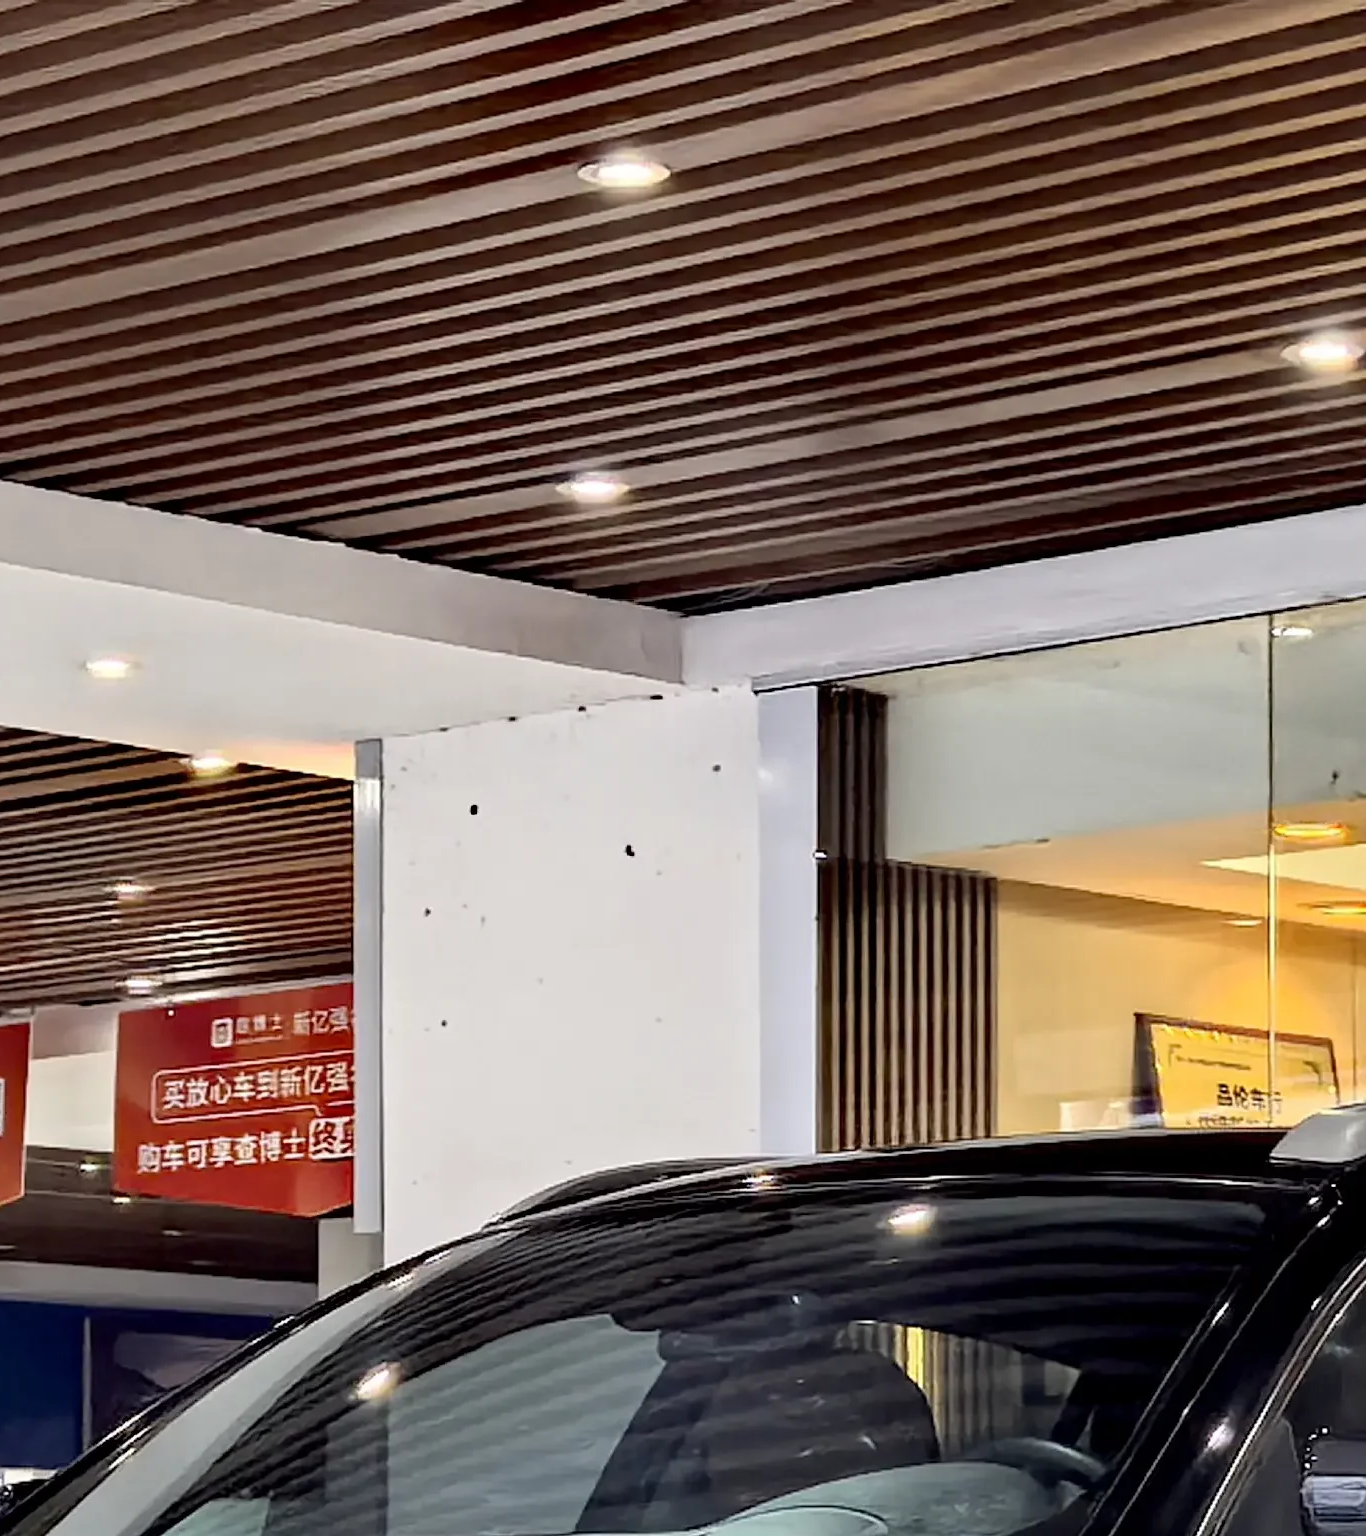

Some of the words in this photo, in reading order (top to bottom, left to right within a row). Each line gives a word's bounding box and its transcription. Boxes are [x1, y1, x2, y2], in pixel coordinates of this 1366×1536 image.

[291, 1005, 354, 1037] 新亿强
[162, 1060, 354, 1111] 买放心车到新亿强
